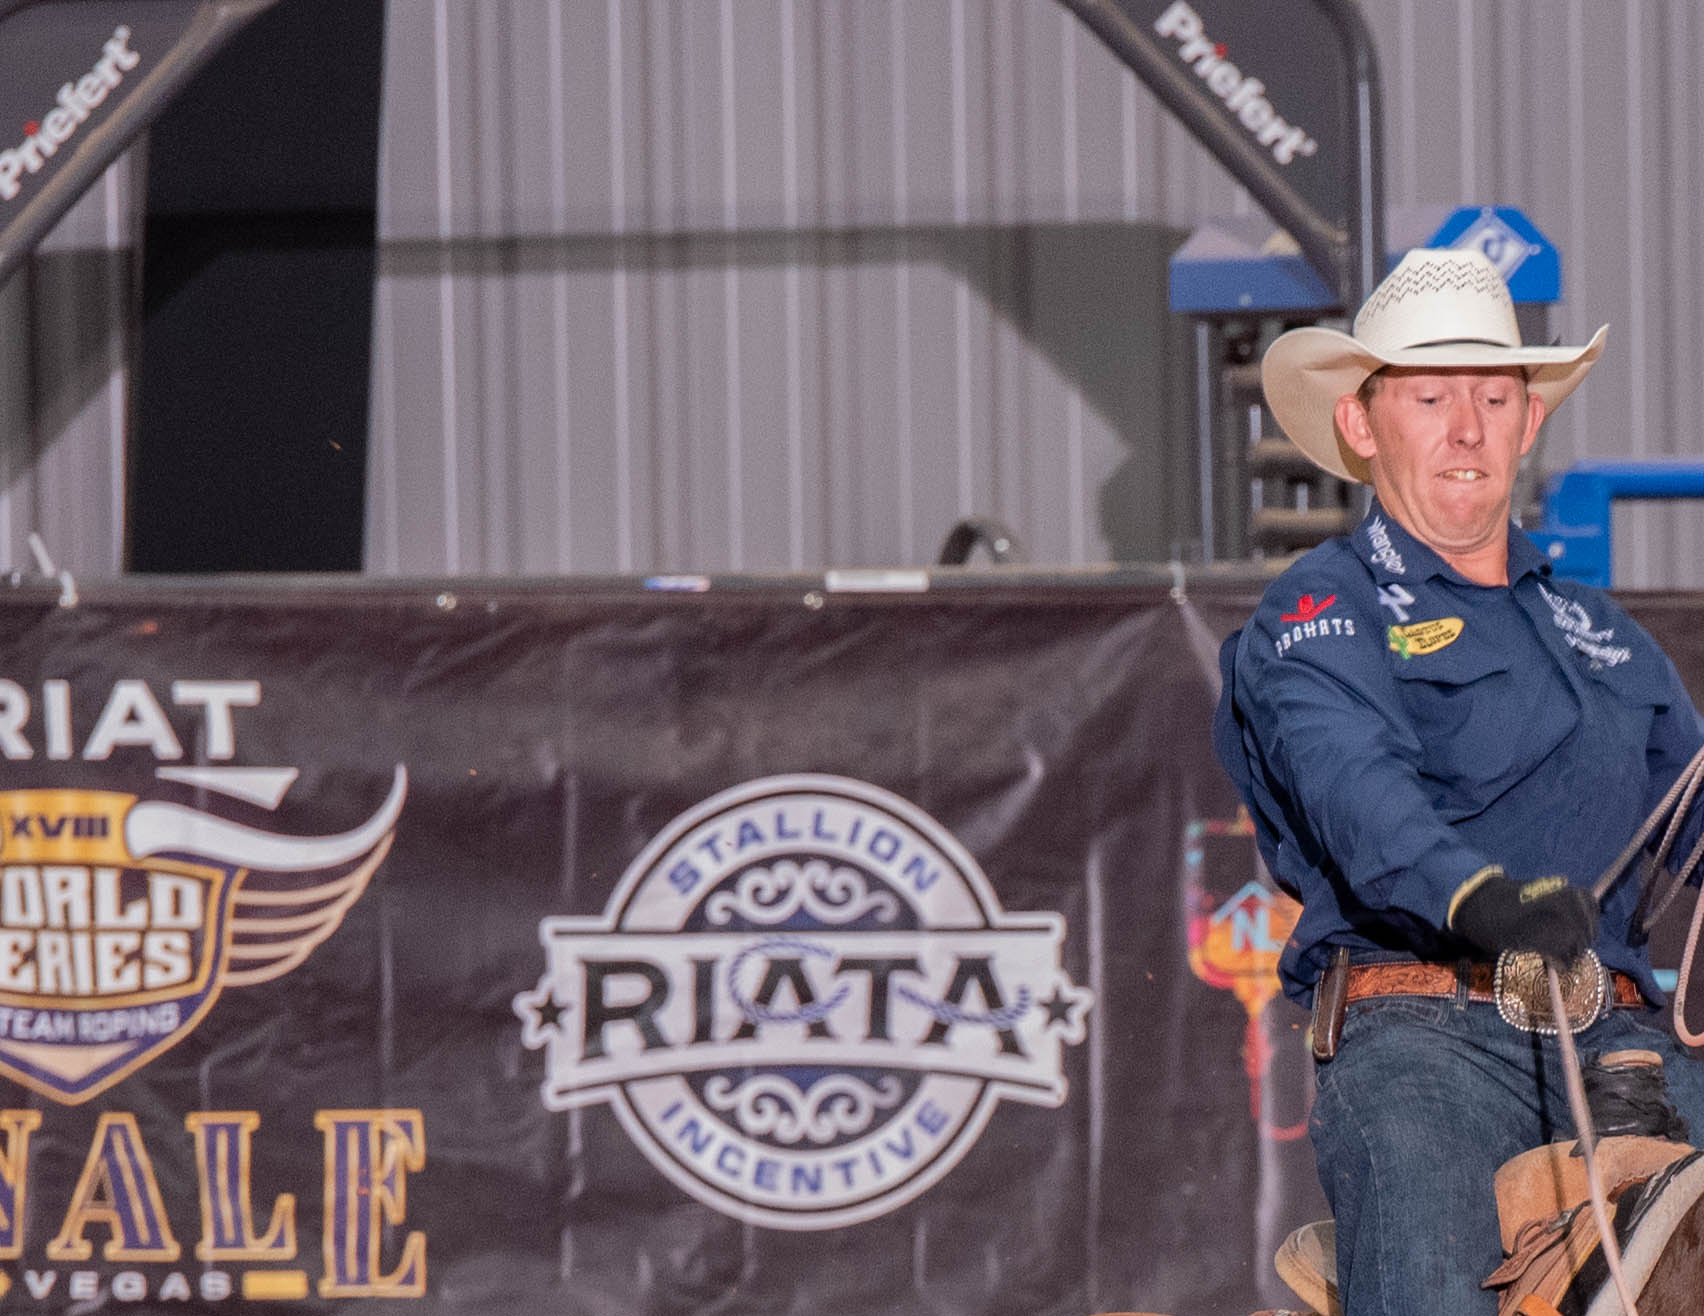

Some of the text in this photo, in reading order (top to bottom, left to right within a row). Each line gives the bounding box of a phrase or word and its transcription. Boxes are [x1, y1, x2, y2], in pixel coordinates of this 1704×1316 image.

[11, 815, 110, 838] XVIII
[667, 810, 942, 896] STALLION
[578, 955, 1034, 1063] RIATA
[660, 1100, 950, 1194] INCENTIVE
[24, 1270, 233, 1301] VEGAS
